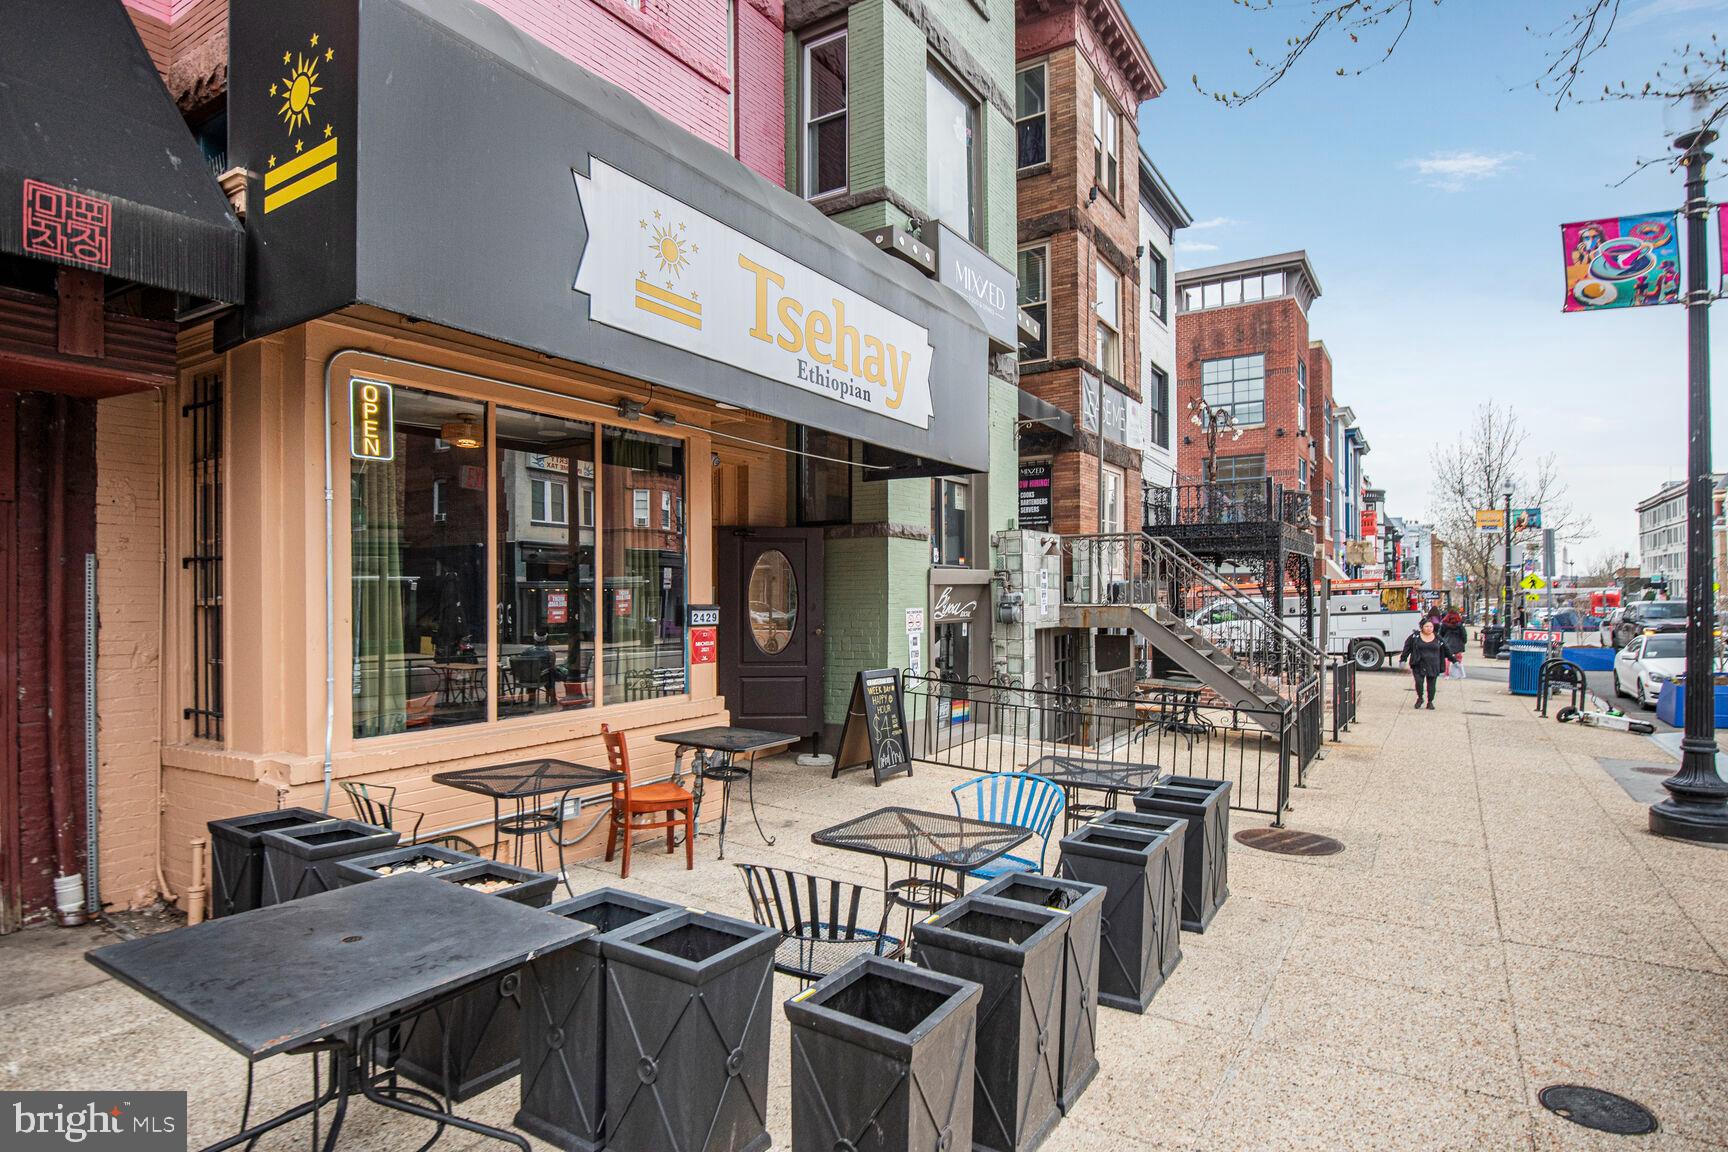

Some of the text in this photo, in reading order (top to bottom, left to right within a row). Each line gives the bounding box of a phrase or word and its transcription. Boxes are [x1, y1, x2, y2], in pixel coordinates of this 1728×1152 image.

[738, 252, 911, 409] Tsehay
[797, 358, 872, 402] Ethiopian
[363, 384, 380, 456] OPEN
[693, 612, 717, 623] 2429
